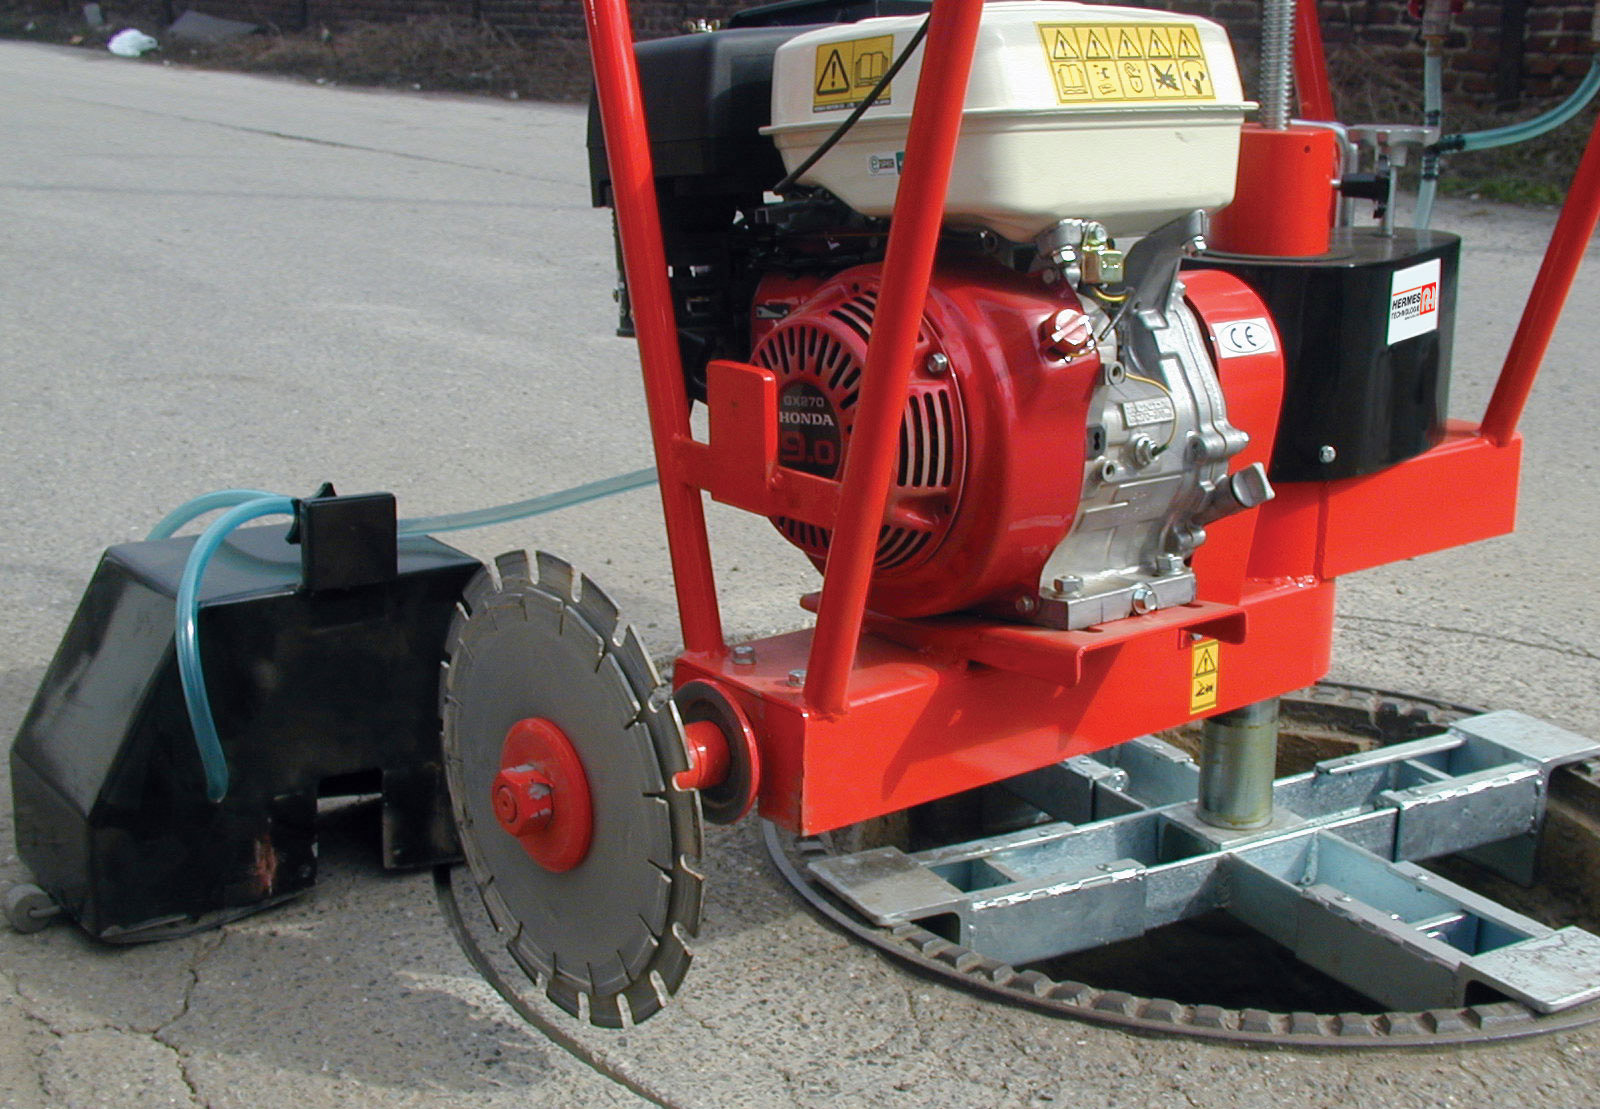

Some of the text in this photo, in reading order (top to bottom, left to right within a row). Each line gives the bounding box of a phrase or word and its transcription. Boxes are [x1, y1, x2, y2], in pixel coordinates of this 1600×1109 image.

[1392, 292, 1421, 310] HERMES
[1231, 326, 1257, 349] CE
[783, 396, 825, 407] GX270
[779, 412, 834, 426] HONDA
[783, 431, 834, 463] 9.0
